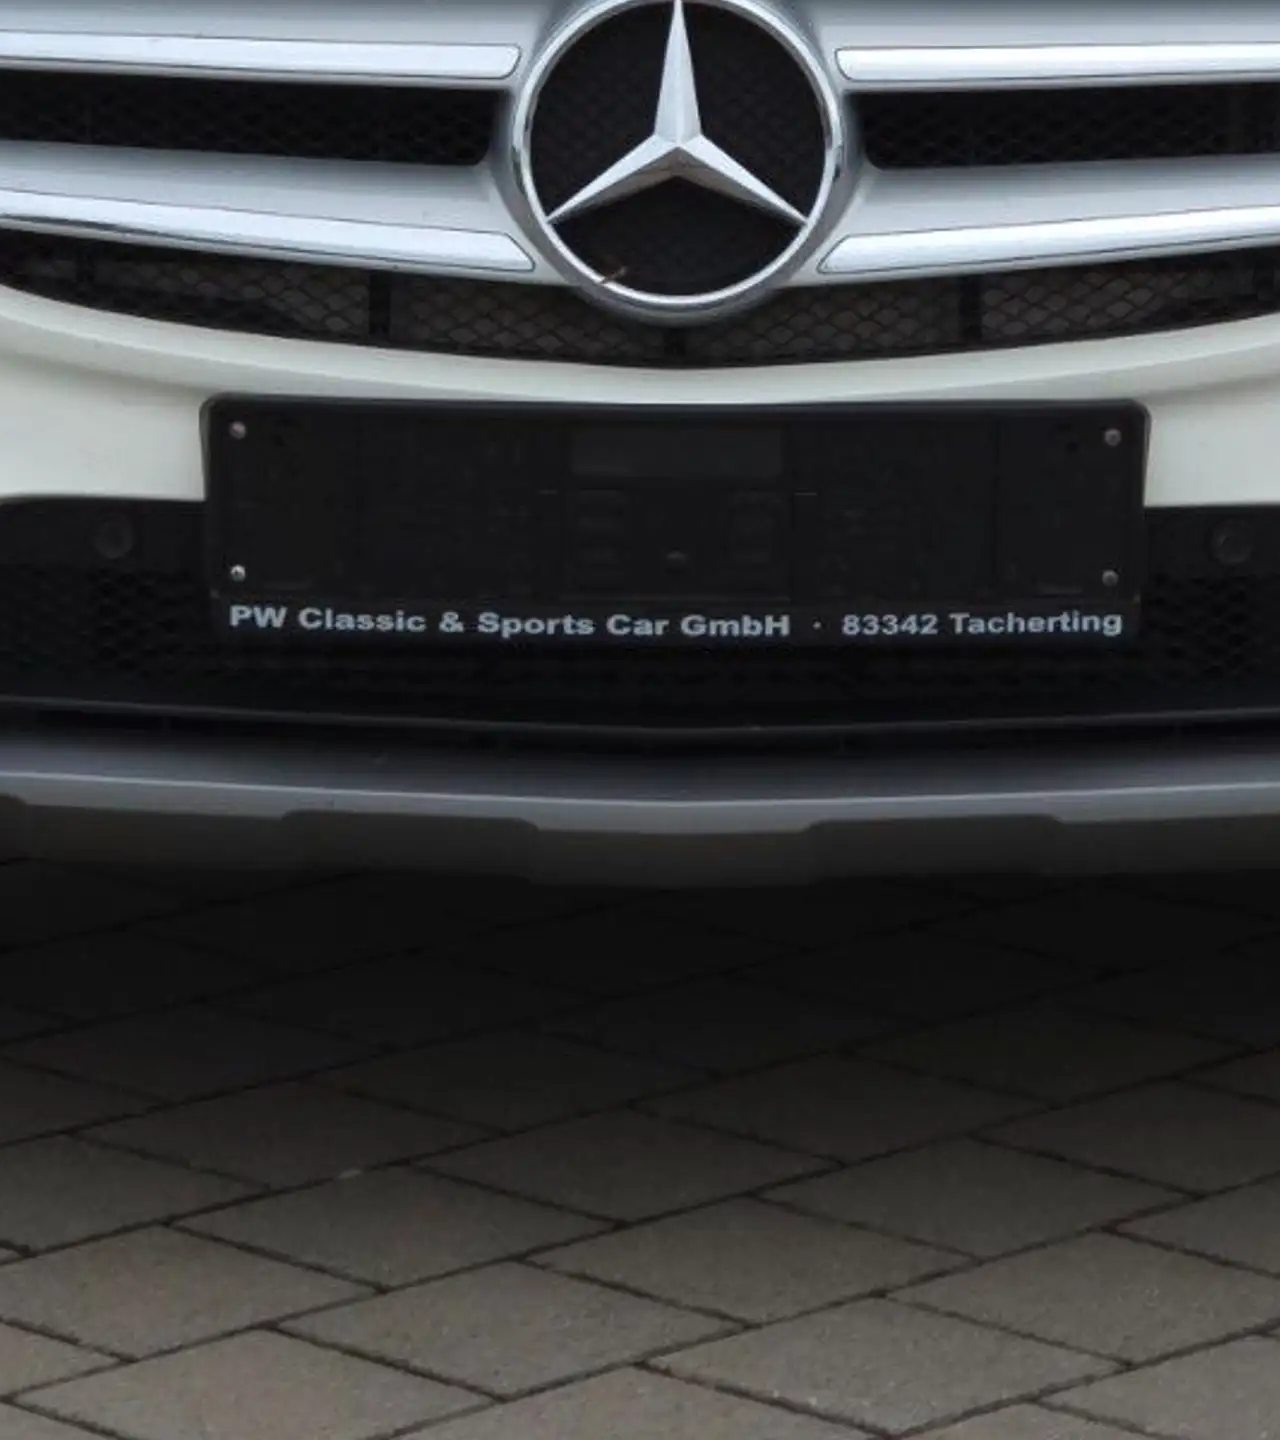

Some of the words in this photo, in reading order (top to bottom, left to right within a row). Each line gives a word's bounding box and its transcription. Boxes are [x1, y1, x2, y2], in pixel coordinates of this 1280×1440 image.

[229, 603, 289, 629] PW
[297, 606, 428, 633] Classic
[438, 610, 466, 634] &
[476, 610, 596, 640] Sports
[605, 613, 671, 637] Car
[679, 613, 791, 638] GmbH
[841, 613, 939, 637] 83342
[947, 609, 1124, 638] Tacherting
